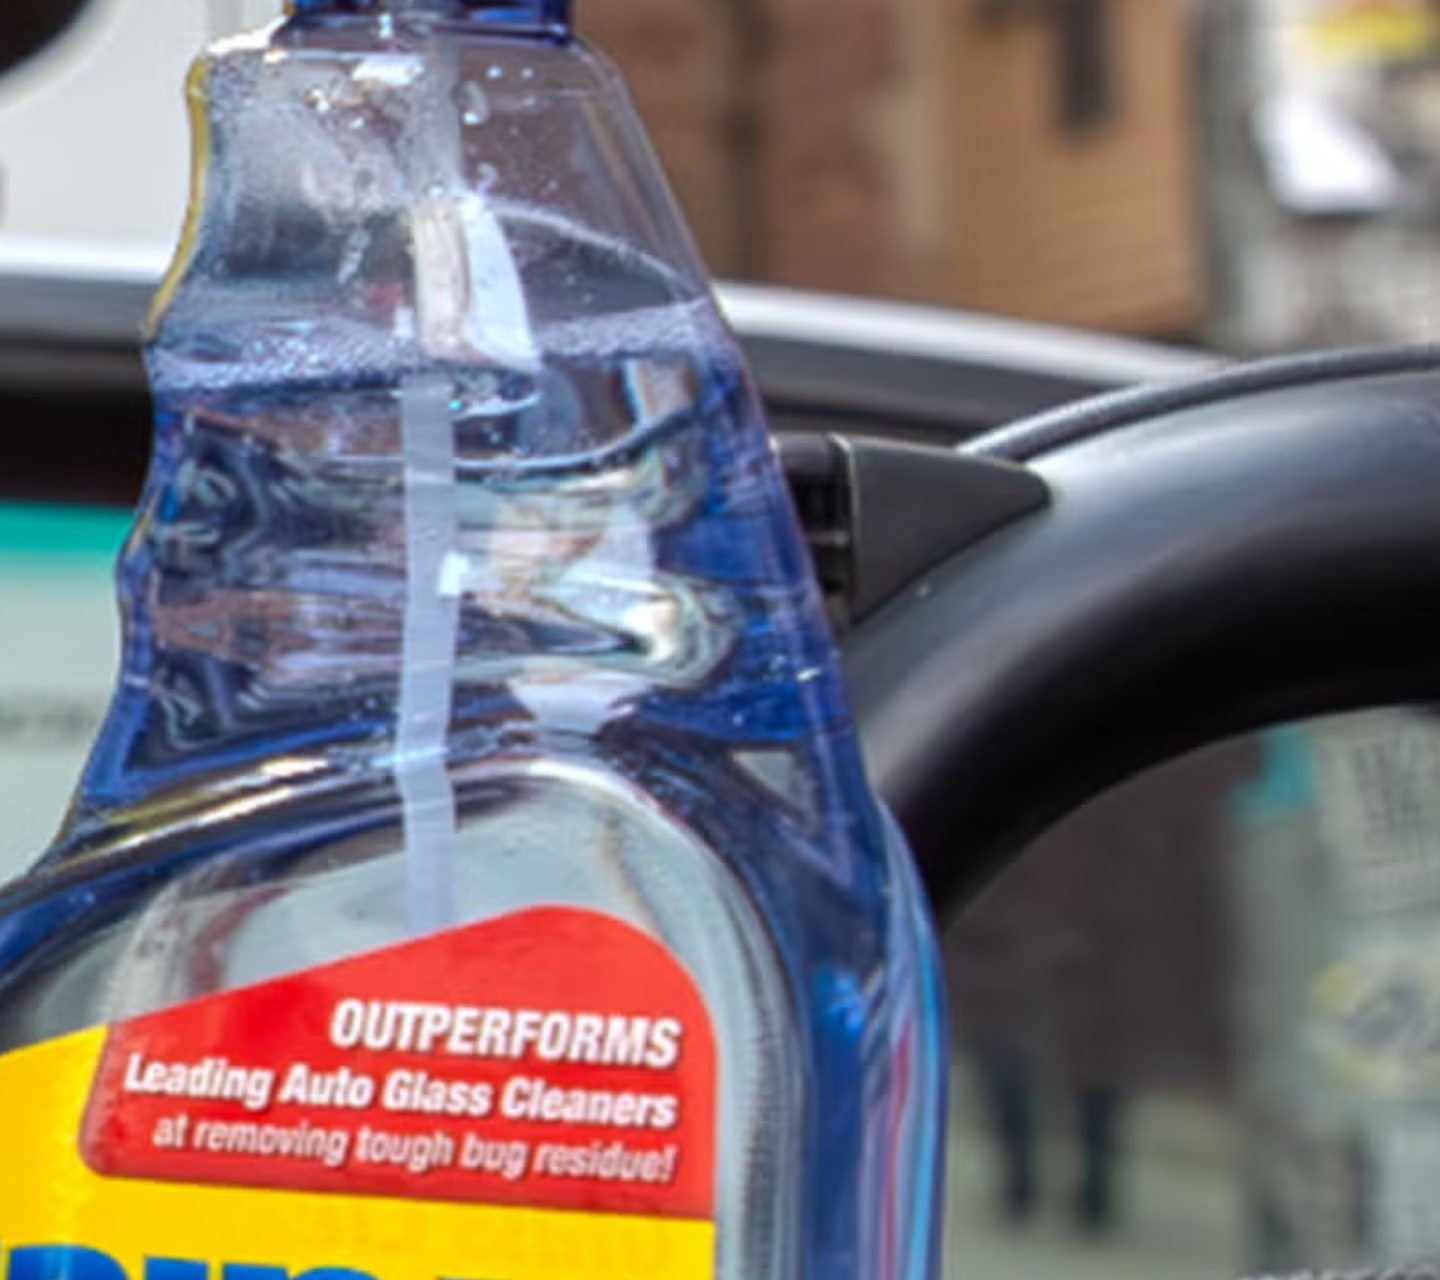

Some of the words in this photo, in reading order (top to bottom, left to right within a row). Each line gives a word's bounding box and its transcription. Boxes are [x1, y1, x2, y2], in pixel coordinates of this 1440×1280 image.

[329, 999, 682, 1069] OUTPERFORMS
[124, 1053, 274, 1110] Leading
[280, 1063, 372, 1111] Auto
[383, 1069, 491, 1119] Glass
[500, 1077, 676, 1130] Cleaners
[152, 1116, 188, 1150] at
[195, 1120, 346, 1167] removing
[355, 1126, 452, 1174] tough
[461, 1133, 526, 1179] bug
[533, 1137, 677, 1185] residue!
